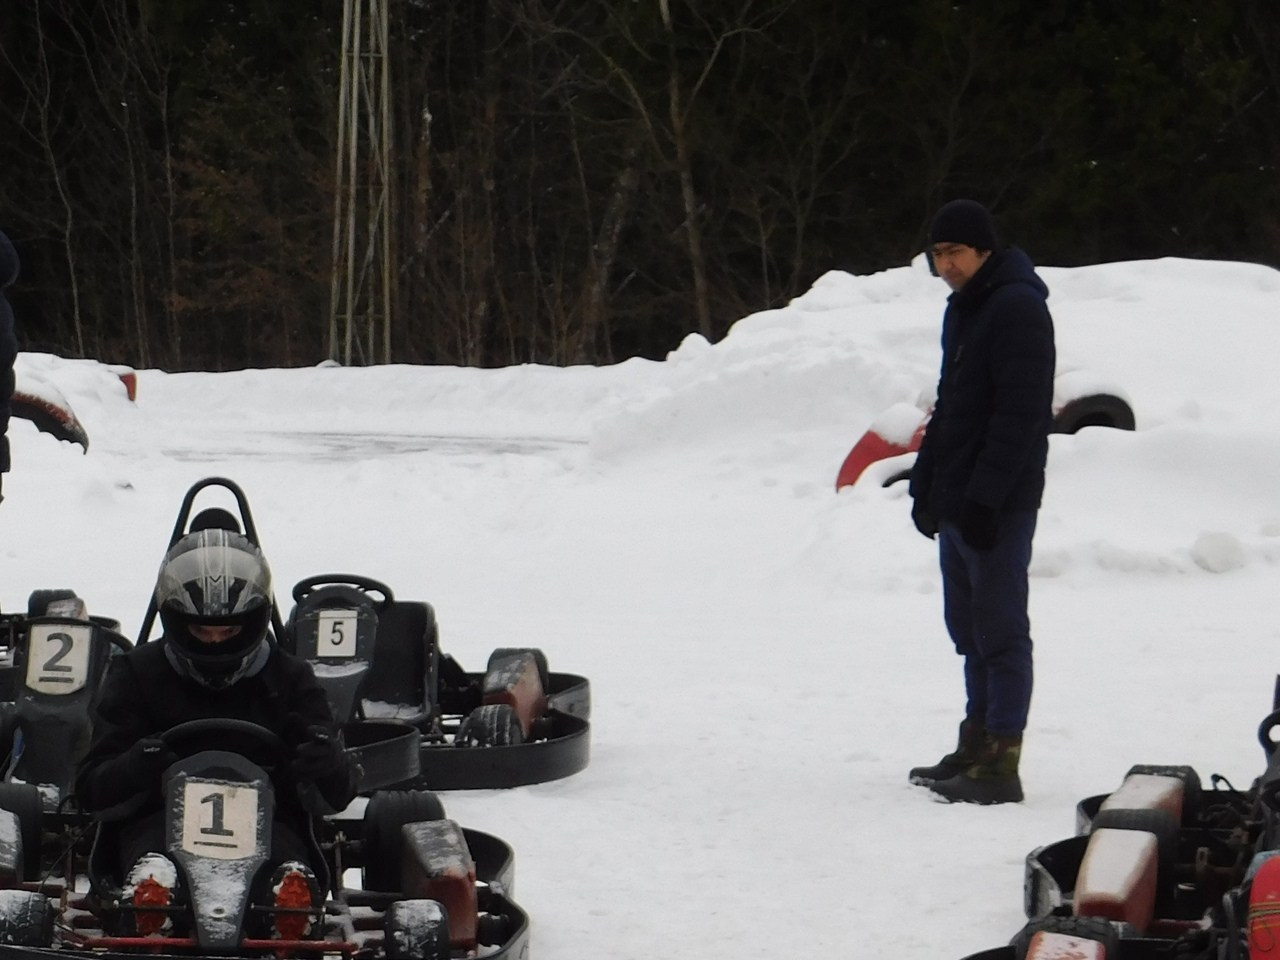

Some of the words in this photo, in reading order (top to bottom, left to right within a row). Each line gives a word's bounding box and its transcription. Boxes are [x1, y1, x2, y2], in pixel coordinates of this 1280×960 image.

[42, 632, 74, 673] 2
[330, 620, 344, 646] 5
[200, 792, 235, 837] 1
